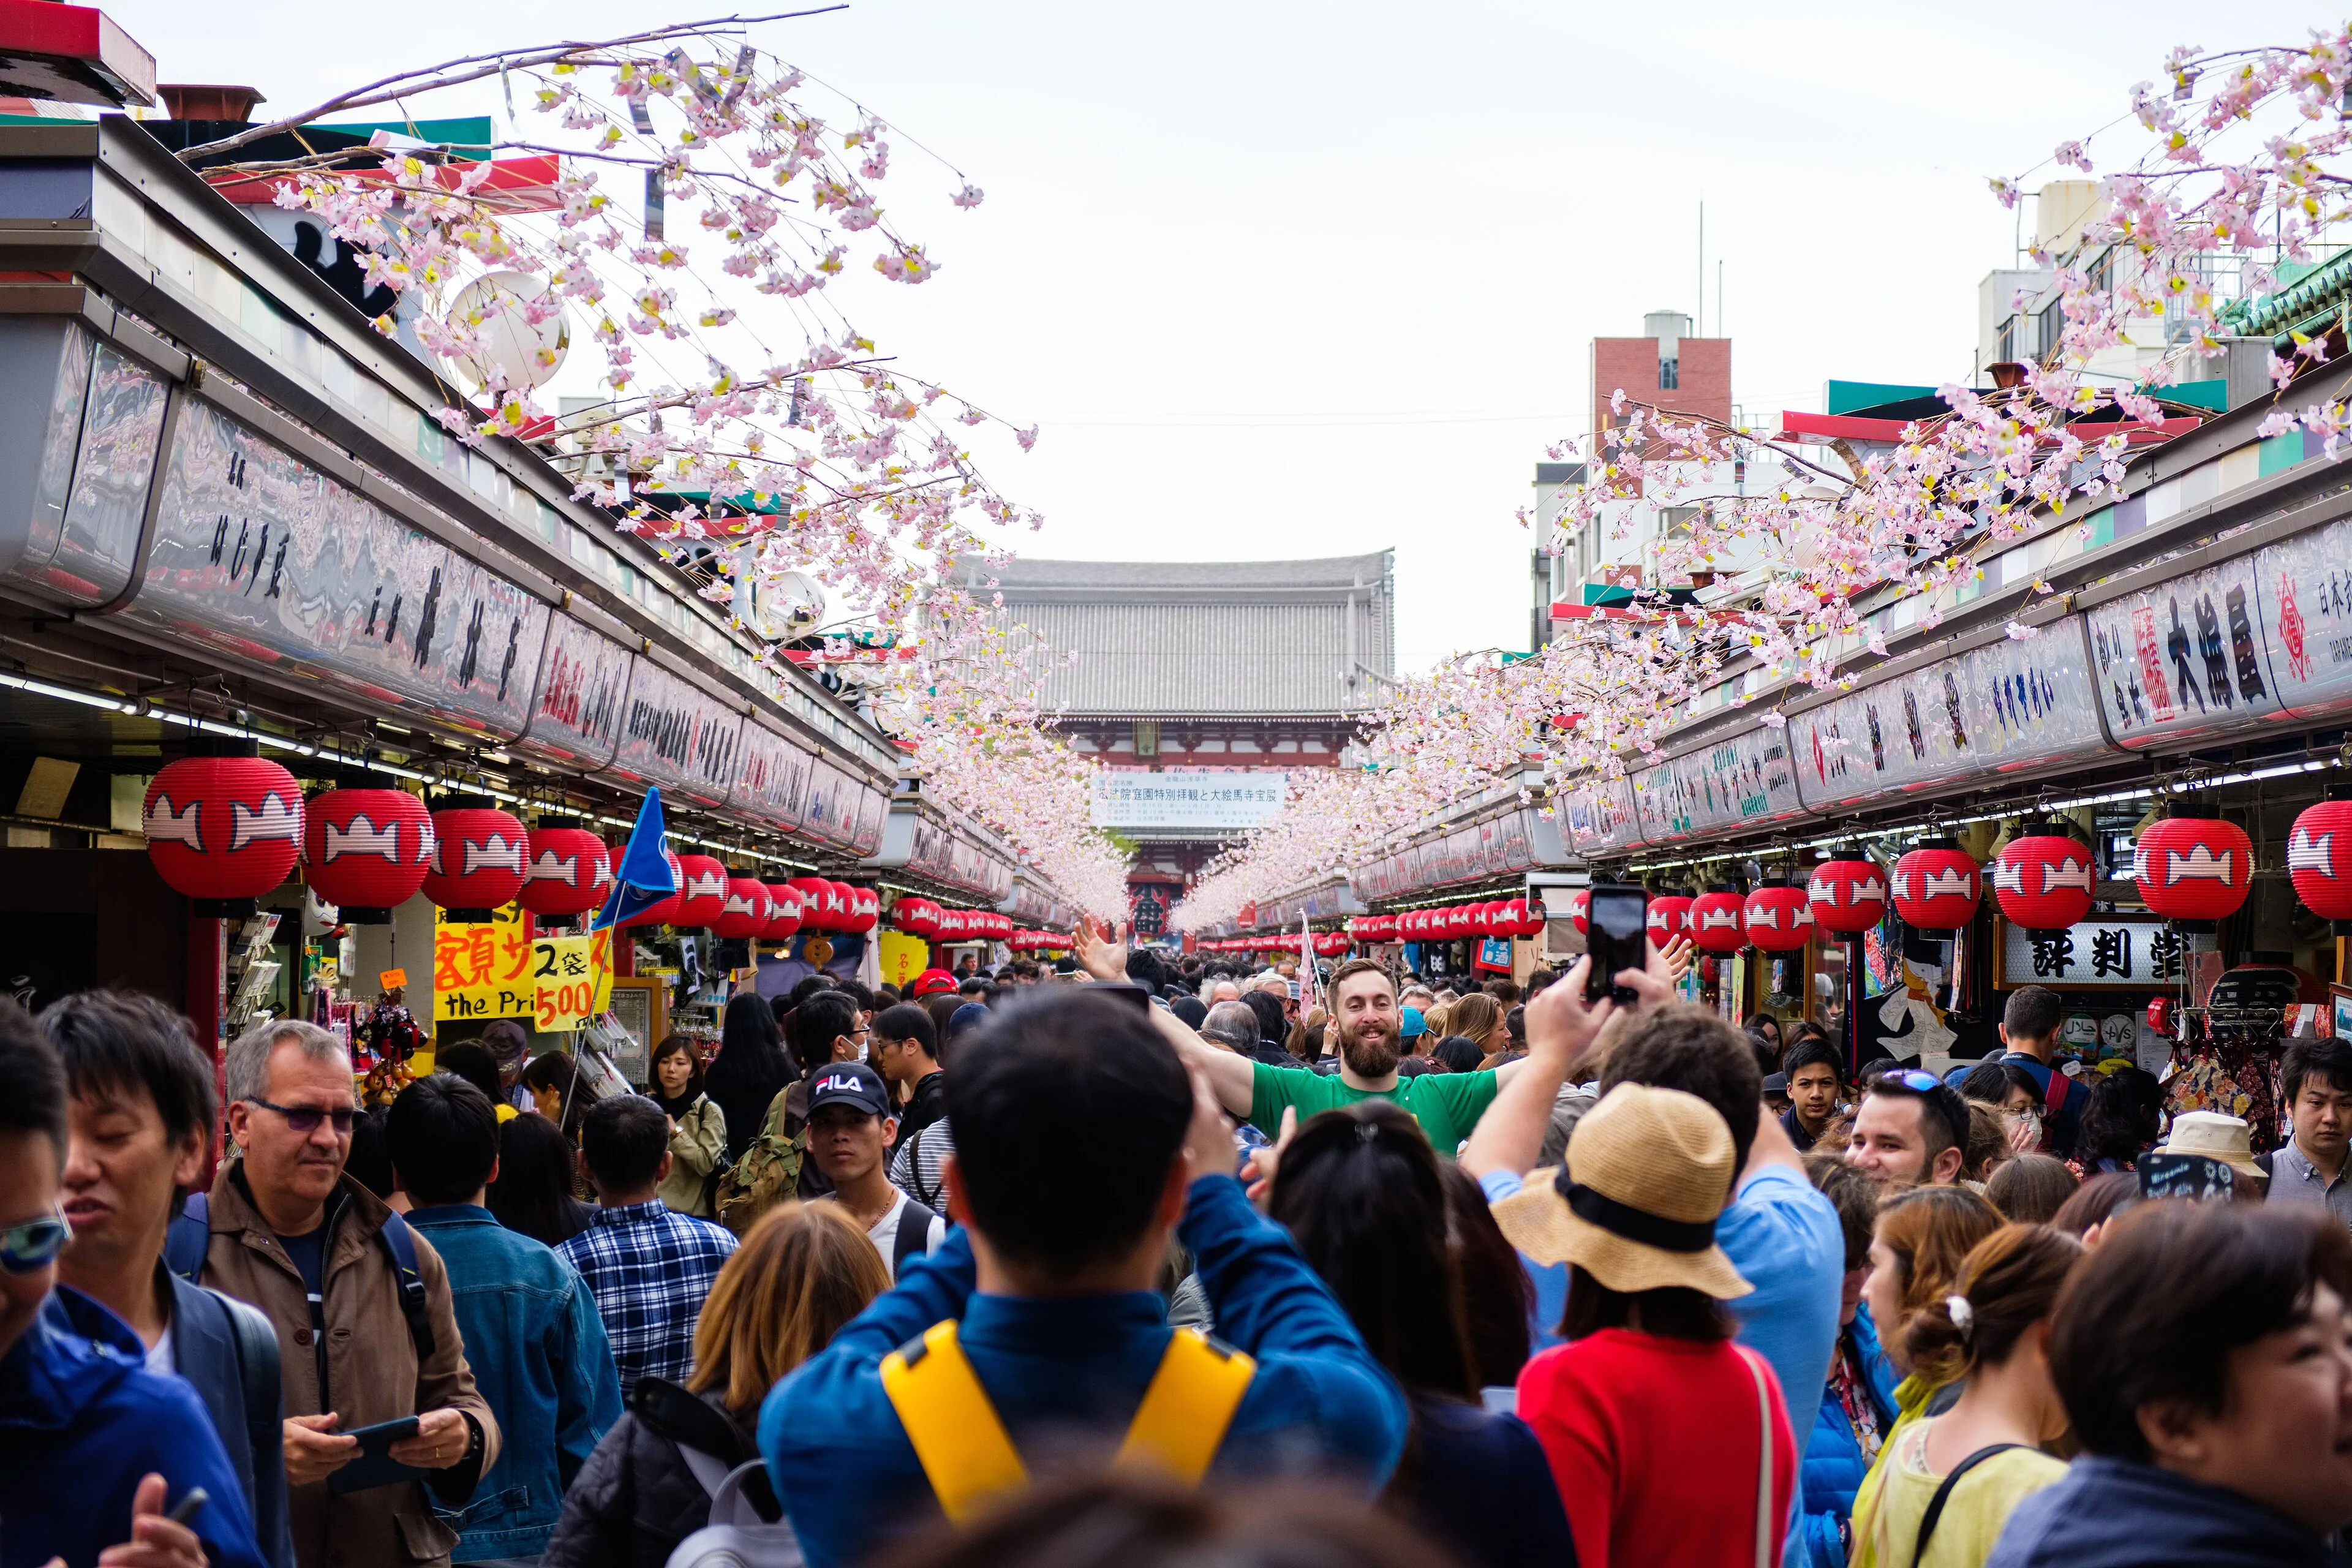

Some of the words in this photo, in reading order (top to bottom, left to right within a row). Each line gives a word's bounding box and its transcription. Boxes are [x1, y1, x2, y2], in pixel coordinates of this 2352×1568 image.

[534, 943, 587, 979] 2袋
[445, 992, 489, 1017] the
[536, 981, 592, 1028] 500
[815, 1074, 863, 1096] FILA
